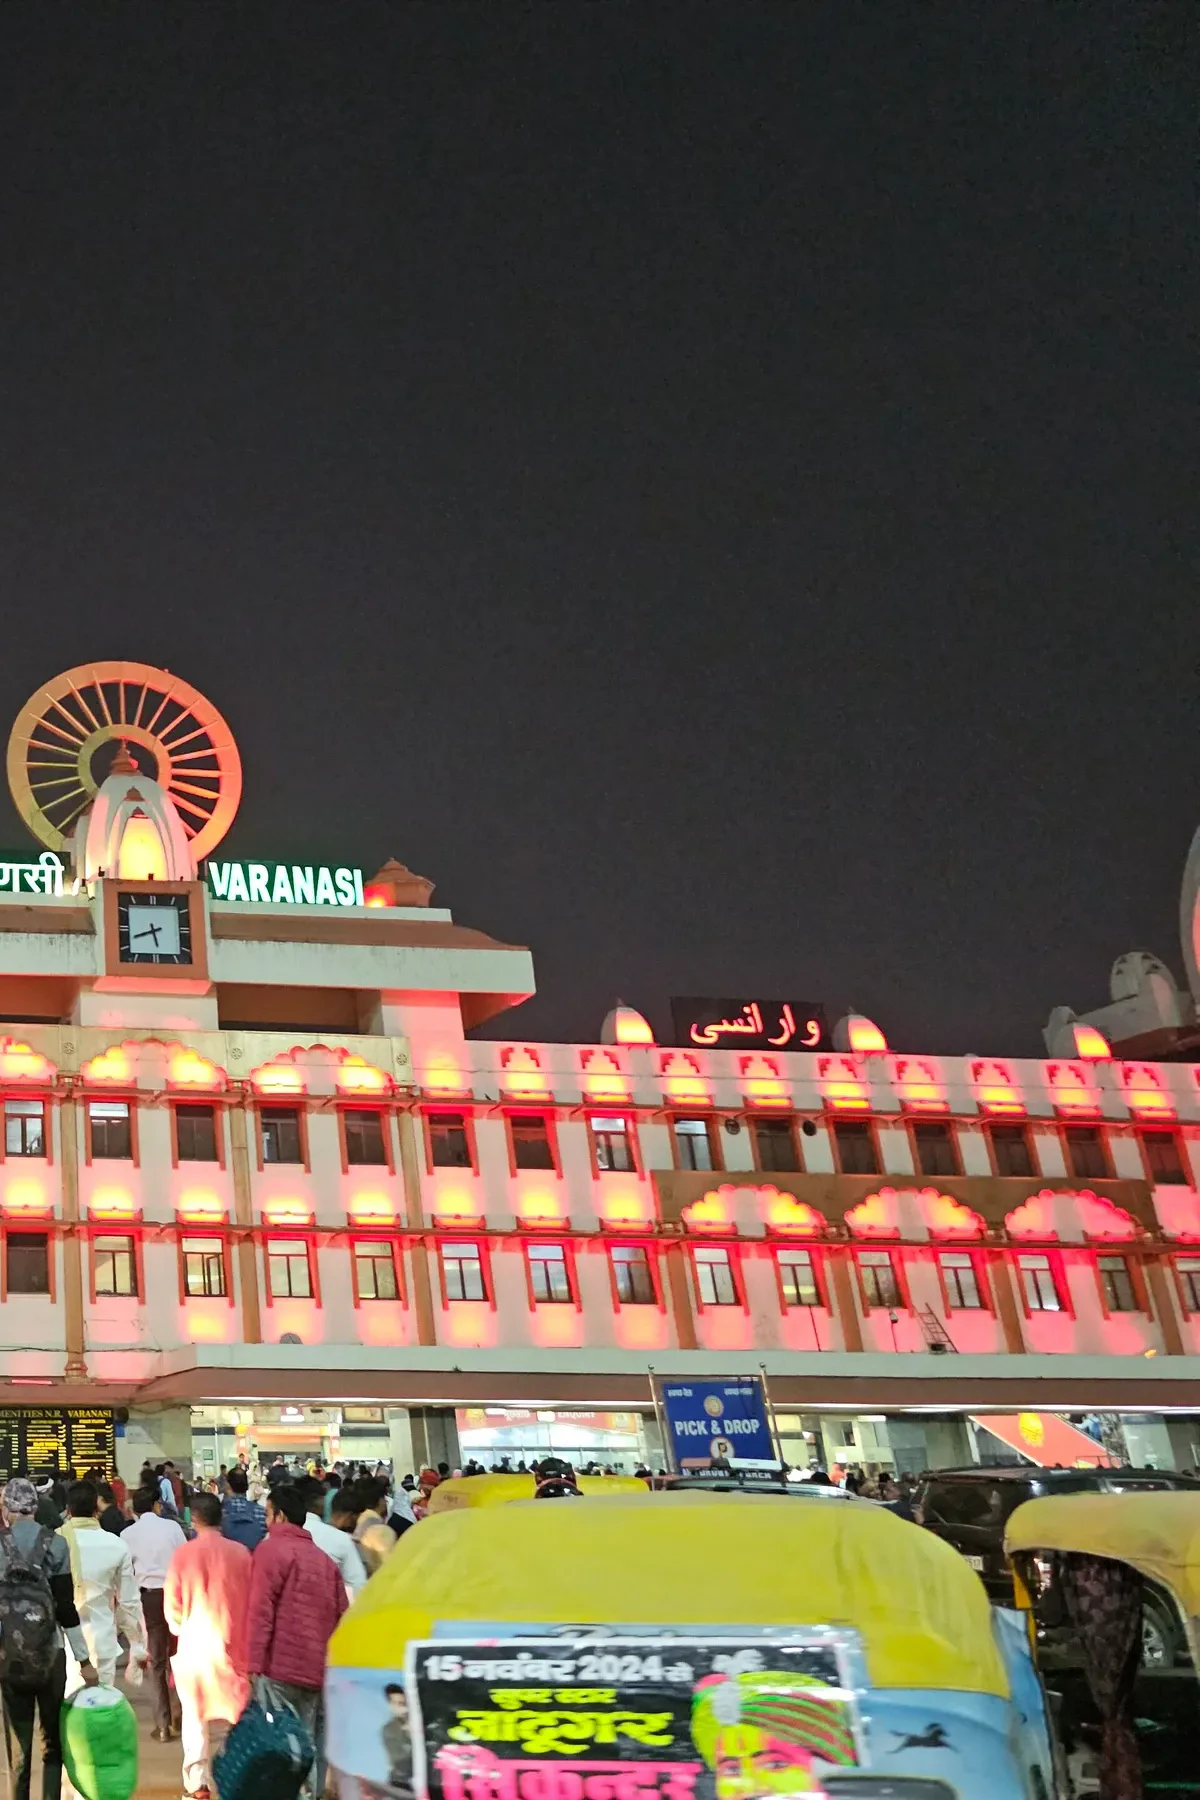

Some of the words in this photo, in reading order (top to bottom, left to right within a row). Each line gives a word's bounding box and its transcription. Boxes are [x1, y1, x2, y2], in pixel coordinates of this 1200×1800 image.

[209, 861, 365, 906] VARANASI
[67, 1410, 112, 1418] VARANASI
[674, 1420, 709, 1436] PICK
[711, 1419, 722, 1435] &
[724, 1419, 760, 1435] DROP
[423, 1655, 462, 1681] 15
[578, 1655, 663, 1681] 2024
[447, 1710, 675, 1754] जादूगर
